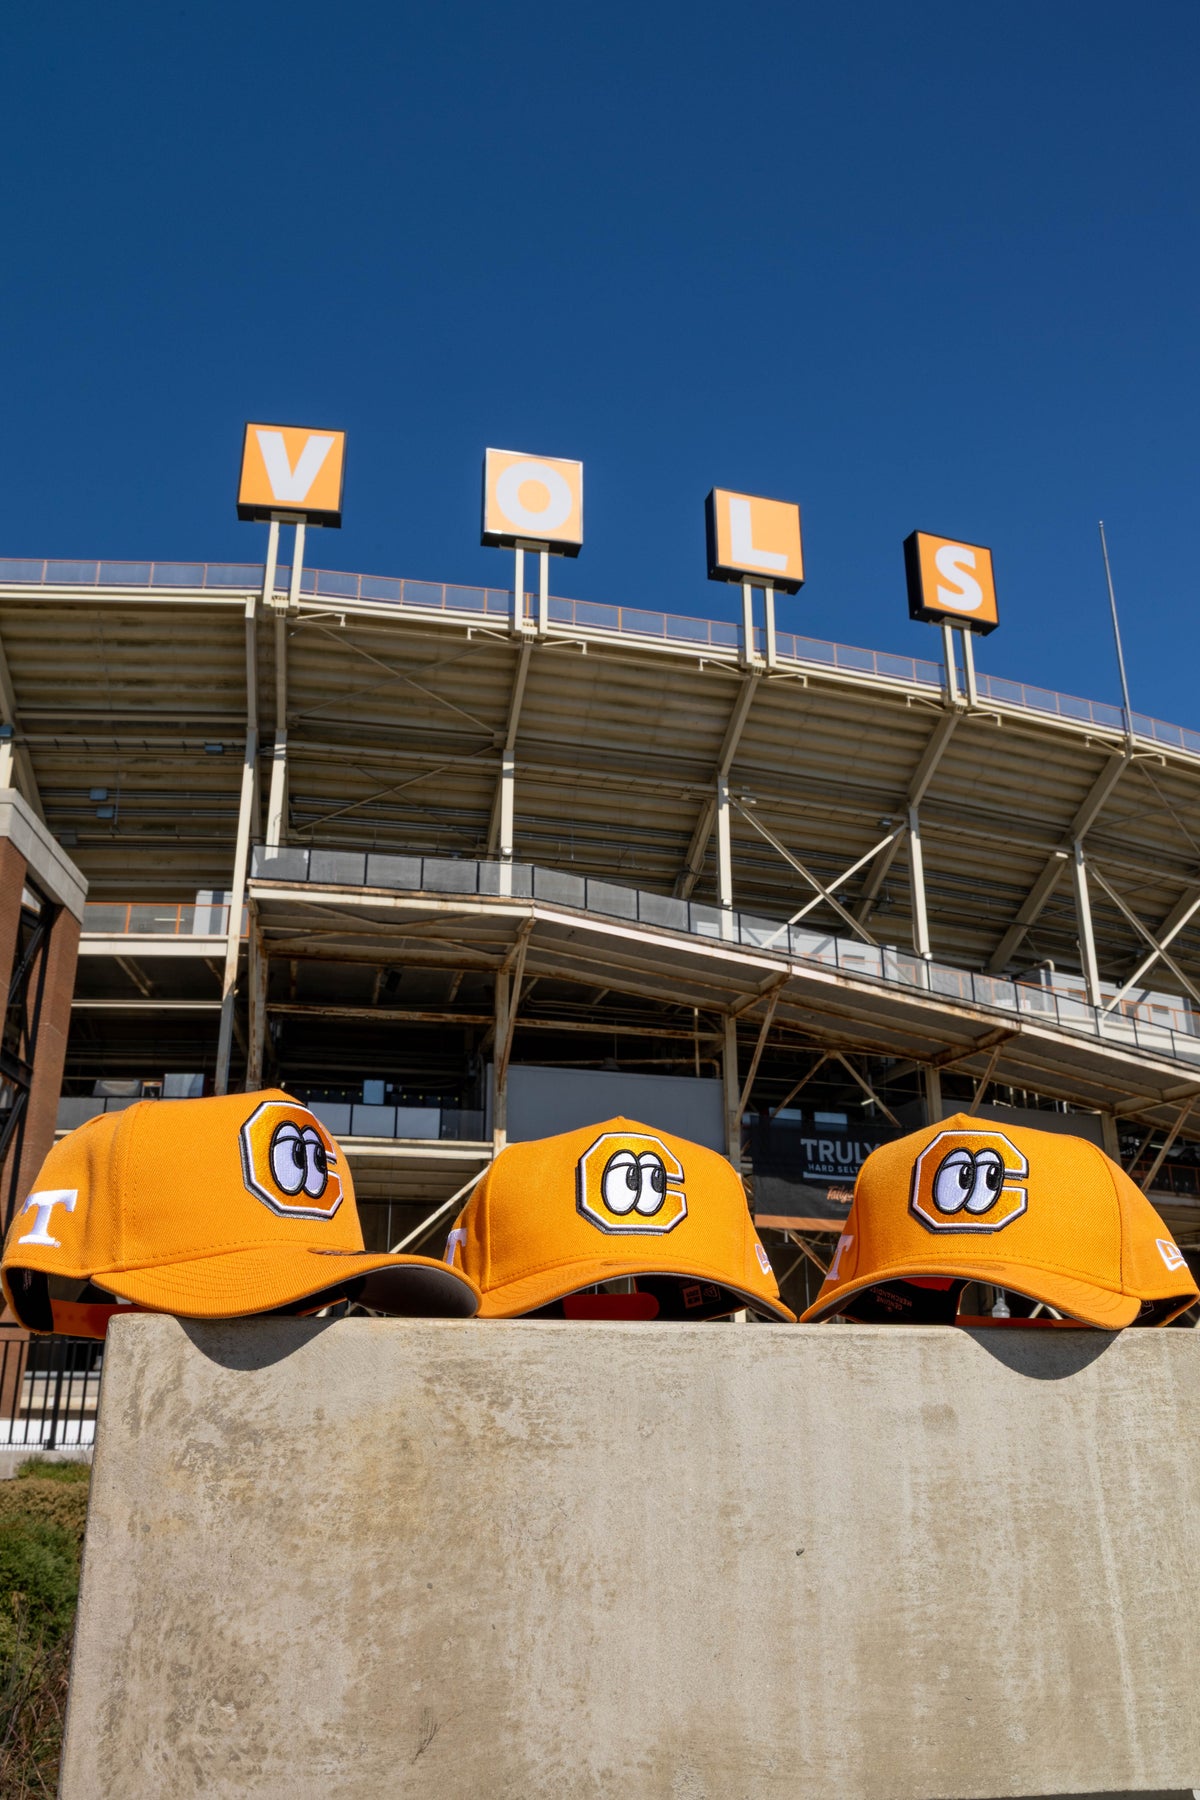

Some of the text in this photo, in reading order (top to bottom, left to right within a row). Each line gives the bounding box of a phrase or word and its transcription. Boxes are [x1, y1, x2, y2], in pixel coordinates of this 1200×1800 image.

[808, 1163, 859, 1174] HARD SELT
[18, 1189, 78, 1246] T
